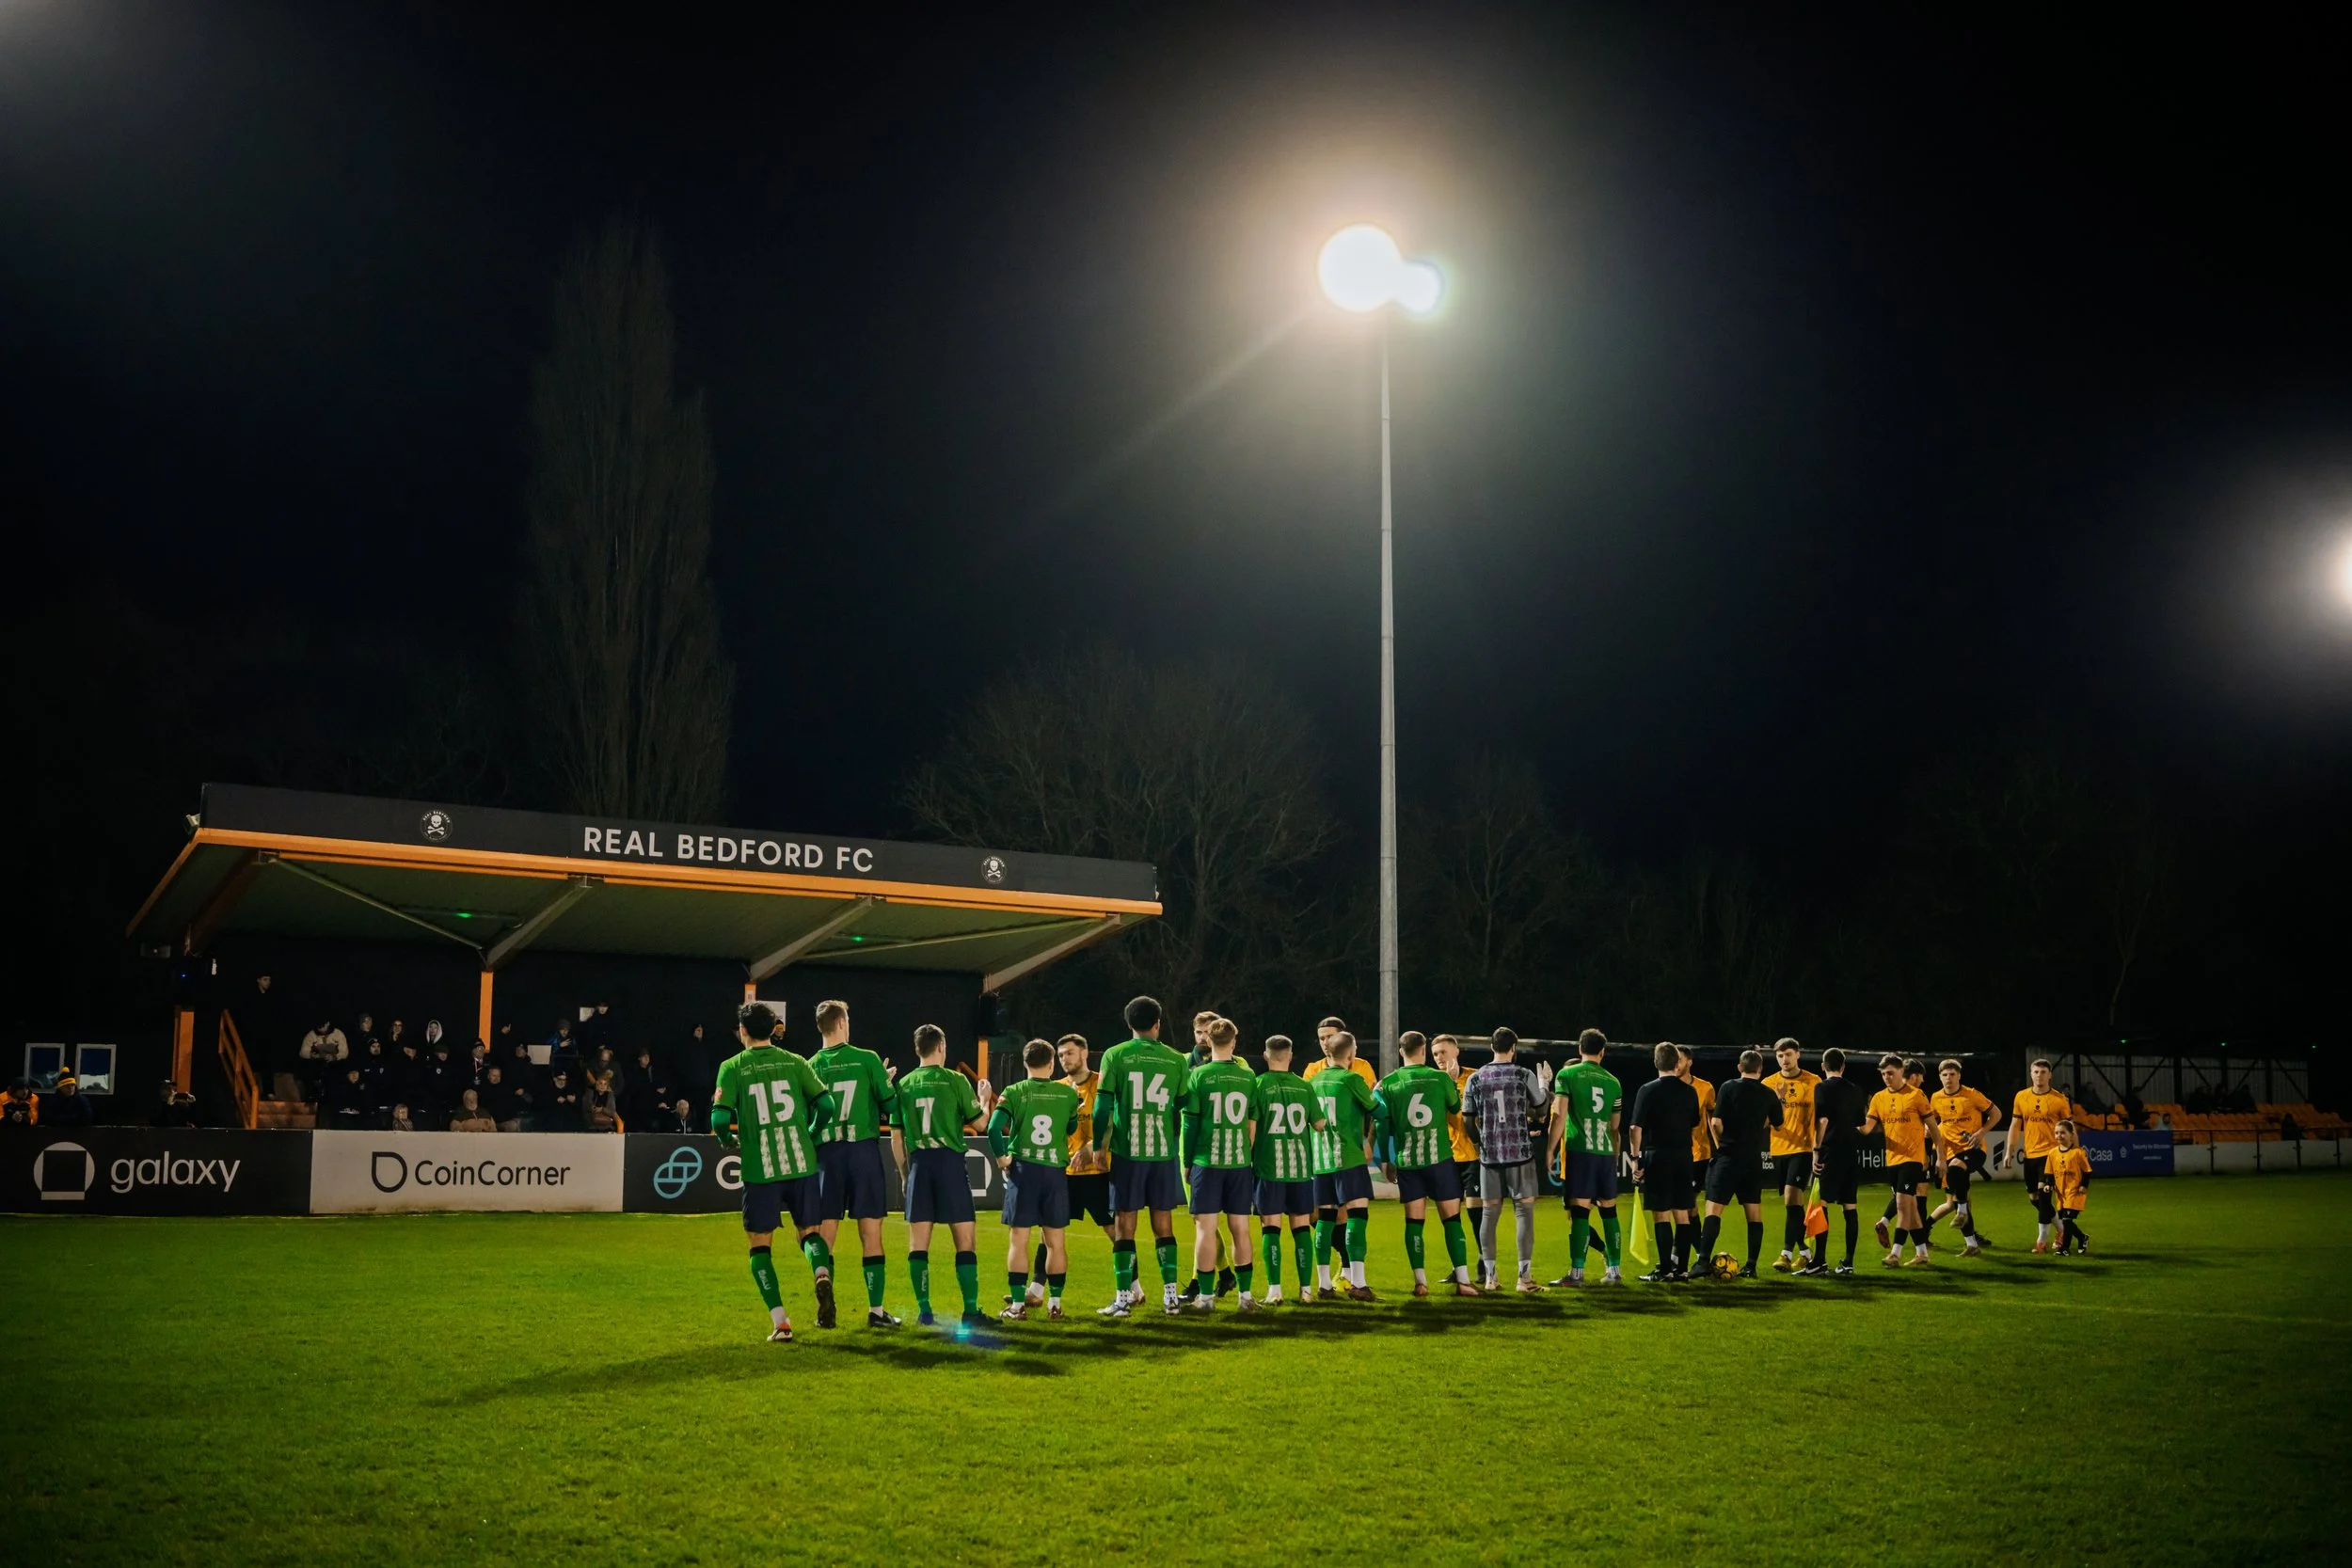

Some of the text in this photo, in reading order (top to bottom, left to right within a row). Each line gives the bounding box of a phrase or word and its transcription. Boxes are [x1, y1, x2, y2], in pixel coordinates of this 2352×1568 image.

[584, 827, 873, 872] REAL BEDFORD FC
[749, 1080, 795, 1125] 15
[828, 1080, 858, 1123] 7
[1128, 1071, 1169, 1112] 14
[1209, 1091, 1248, 1125] 10
[1493, 1090, 1505, 1123] 1
[1591, 1086, 1605, 1114] 5
[915, 1097, 935, 1134] 7
[1268, 1102, 1307, 1135] 20
[1407, 1093, 1433, 1128] 6
[1030, 1115, 1053, 1146] 8
[1863, 1148, 1884, 1168] Hel
[2090, 1148, 2113, 1161] Casa
[110, 1150, 241, 1194] galaxy
[415, 1160, 571, 1186] CoinCorner
